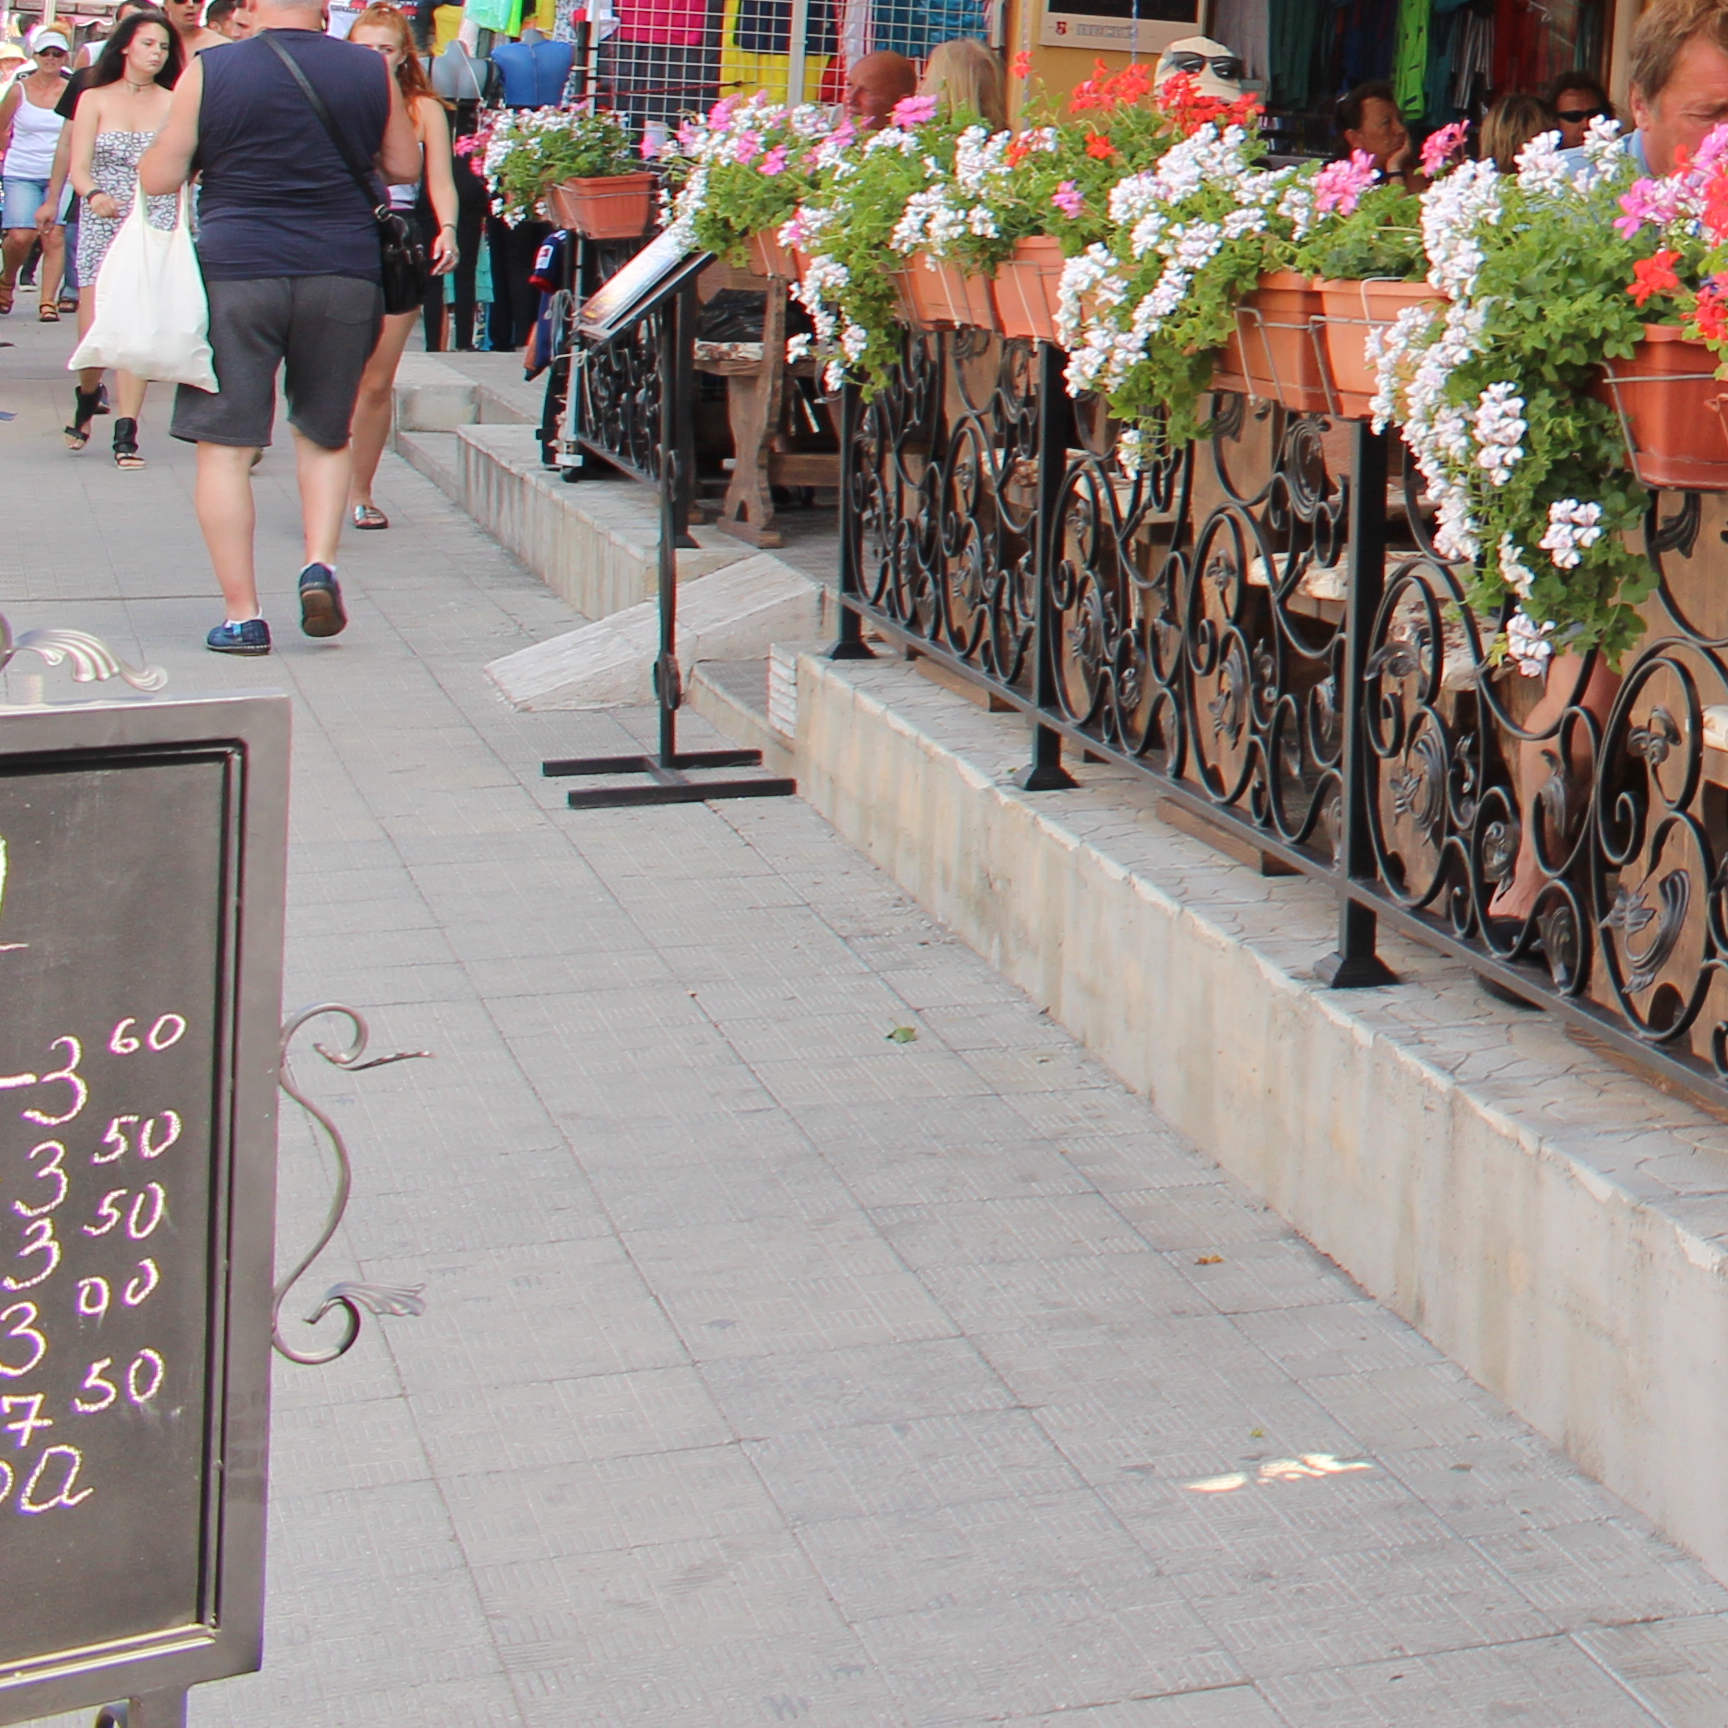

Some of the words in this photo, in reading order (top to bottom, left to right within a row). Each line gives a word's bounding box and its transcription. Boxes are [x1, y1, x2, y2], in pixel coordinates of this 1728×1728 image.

[95, 1110, 181, 1164] 50
[84, 1182, 166, 1240] 50
[74, 1348, 164, 1413] 50
